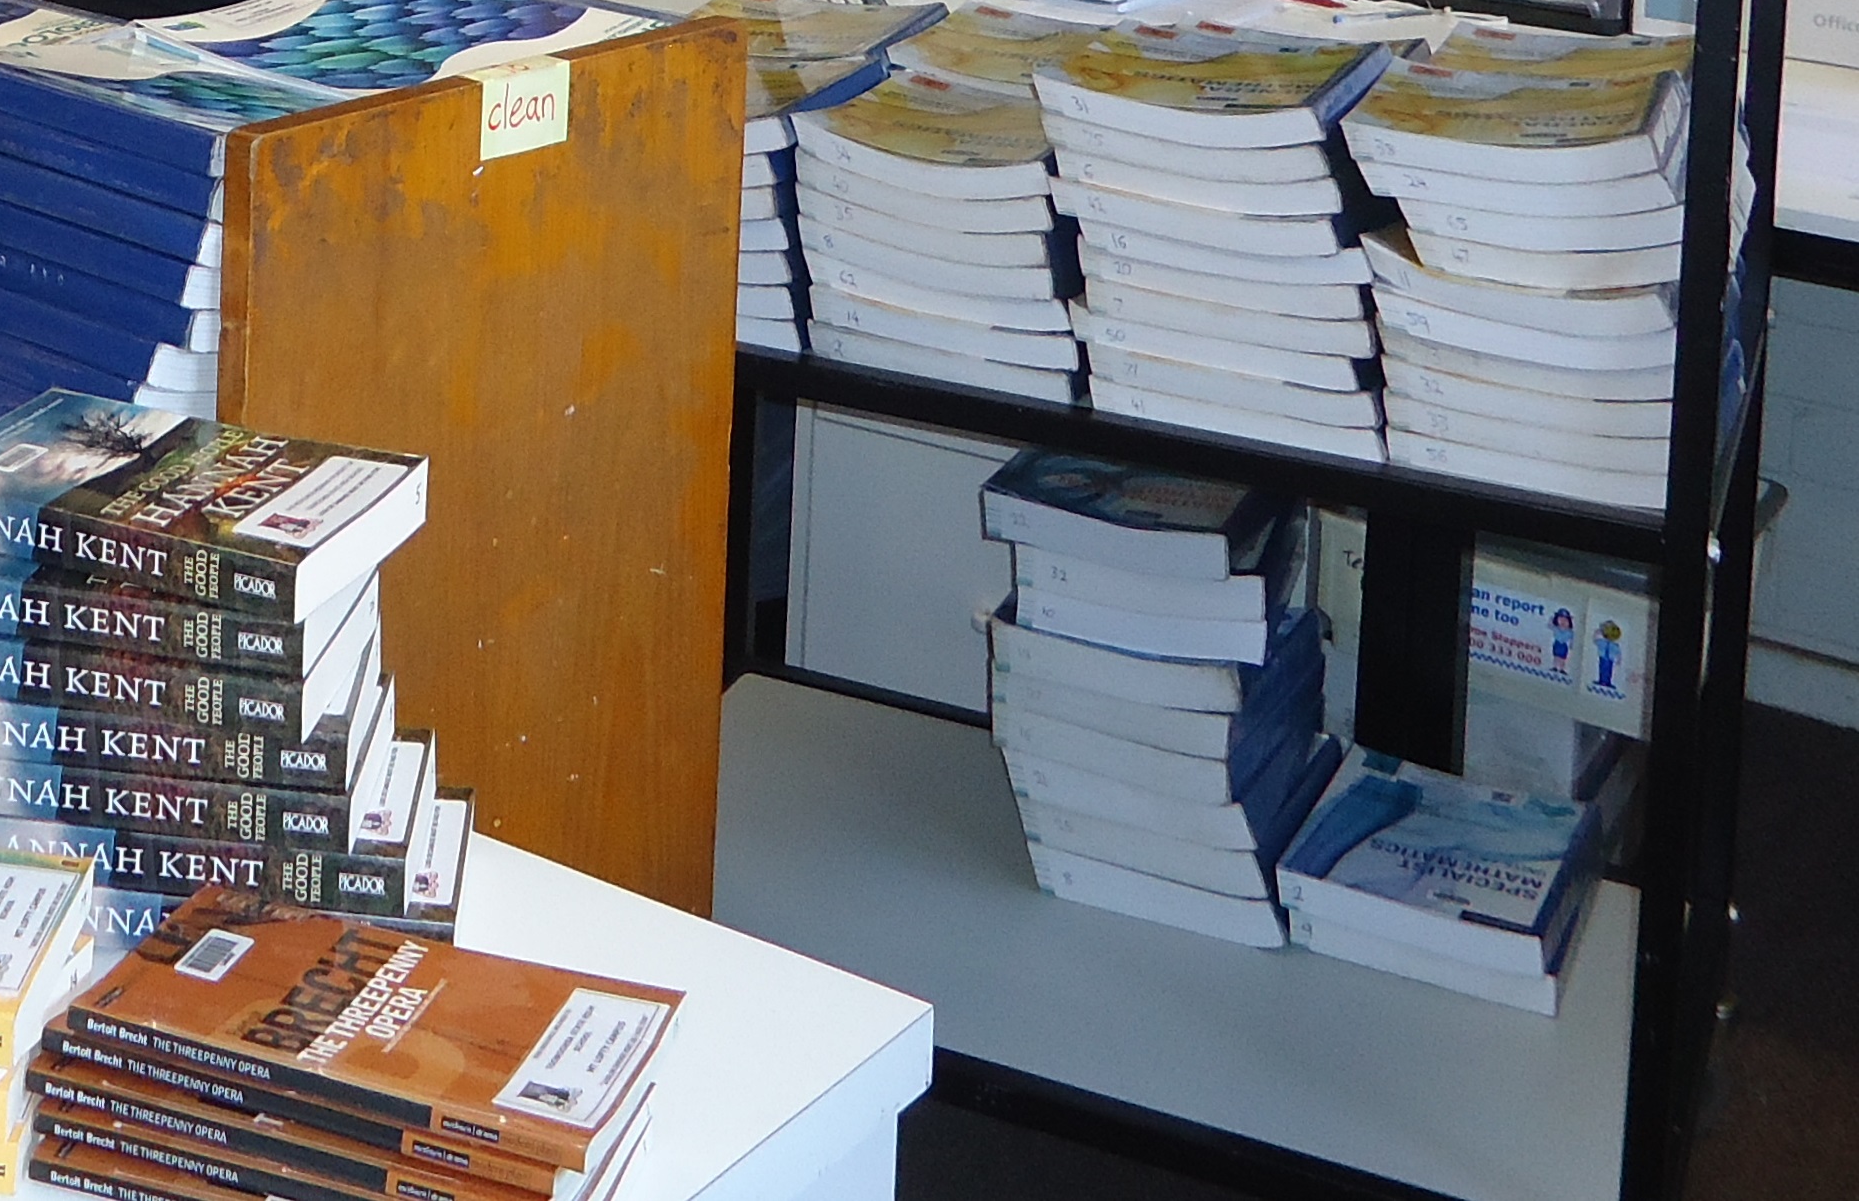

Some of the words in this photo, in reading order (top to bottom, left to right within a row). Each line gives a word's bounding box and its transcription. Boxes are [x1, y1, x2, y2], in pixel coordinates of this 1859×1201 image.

[487, 82, 558, 133] clean
[846, 309, 861, 327] 14
[1104, 327, 1127, 343] 50
[99, 491, 141, 517] THE
[139, 463, 191, 492] GOOD
[130, 435, 290, 528] HANNAH
[201, 457, 311, 519] KENT
[415, 482, 423, 505] 5
[74, 530, 168, 577] KENT
[183, 555, 194, 585] THE
[194, 549, 208, 597] GOOD
[208, 552, 220, 599] PEOPLE
[233, 572, 277, 599] PICADOR
[62, 602, 166, 643] KENT
[1494, 593, 1545, 616] report
[1494, 608, 1520, 626] too
[183, 619, 194, 648] THE
[195, 611, 210, 659] GOOD
[210, 614, 222, 661] PEOPLE
[237, 631, 285, 656] PICADOR
[63, 665, 166, 707] KENT
[184, 683, 195, 713] THE
[196, 676, 210, 724] GOOD
[212, 679, 223, 726] PEOPLE
[238, 696, 285, 721] PICADOR
[100, 728, 206, 765] KENT
[224, 739, 235, 769] THE
[236, 732, 250, 780] GOOD
[252, 735, 264, 780] PEOPLE
[280, 749, 327, 772] PICADOR
[104, 787, 209, 825] KENT
[227, 800, 238, 829] THE
[239, 792, 253, 841] GOOD
[255, 793, 267, 842] PEOPLE
[282, 810, 330, 835] PICADOR
[158, 850, 264, 888] KENT
[282, 861, 293, 891] THE
[294, 852, 309, 903] GOOD
[310, 854, 323, 903] PEOPLE
[1369, 838, 1543, 888] MATHEMATICS
[1395, 857, 1539, 901] SPECIALIST
[338, 872, 385, 896] PICADOR
[296, 1029, 339, 1065] THE
[331, 939, 429, 1045] THREEPENNY
[365, 986, 429, 1041] OPERA
[568, 1018, 587, 1035] STATE
[604, 1020, 627, 1045] CAMPUS
[86, 1017, 117, 1037] Bertolt
[118, 1027, 148, 1046] Brecht
[152, 1035, 172, 1053] THE
[172, 1041, 238, 1071] THREEPENNY
[238, 1059, 271, 1080] OPERA
[586, 1064, 598, 1073] MT
[591, 1045, 610, 1064] LOFTY
[62, 1040, 92, 1060] Bertolt
[93, 1049, 123, 1069] Brecht
[127, 1058, 147, 1076] THE
[147, 1064, 211, 1094] THREEPENNY
[211, 1082, 244, 1104] OPERA
[44, 1082, 75, 1102] Bertolt
[76, 1090, 106, 1110] Brecht
[110, 1099, 130, 1117] THE
[130, 1105, 194, 1135] THREEPENNY
[194, 1123, 228, 1145] OPERA
[53, 1123, 84, 1142] Bertolt
[86, 1131, 115, 1150] Brecht
[119, 1140, 140, 1158] THE
[139, 1146, 205, 1176] THREEPENNY
[205, 1162, 239, 1184] OPERA
[50, 1170, 81, 1188] Bertolt
[82, 1178, 113, 1196] Brecht
[117, 1185, 138, 1201] THE
